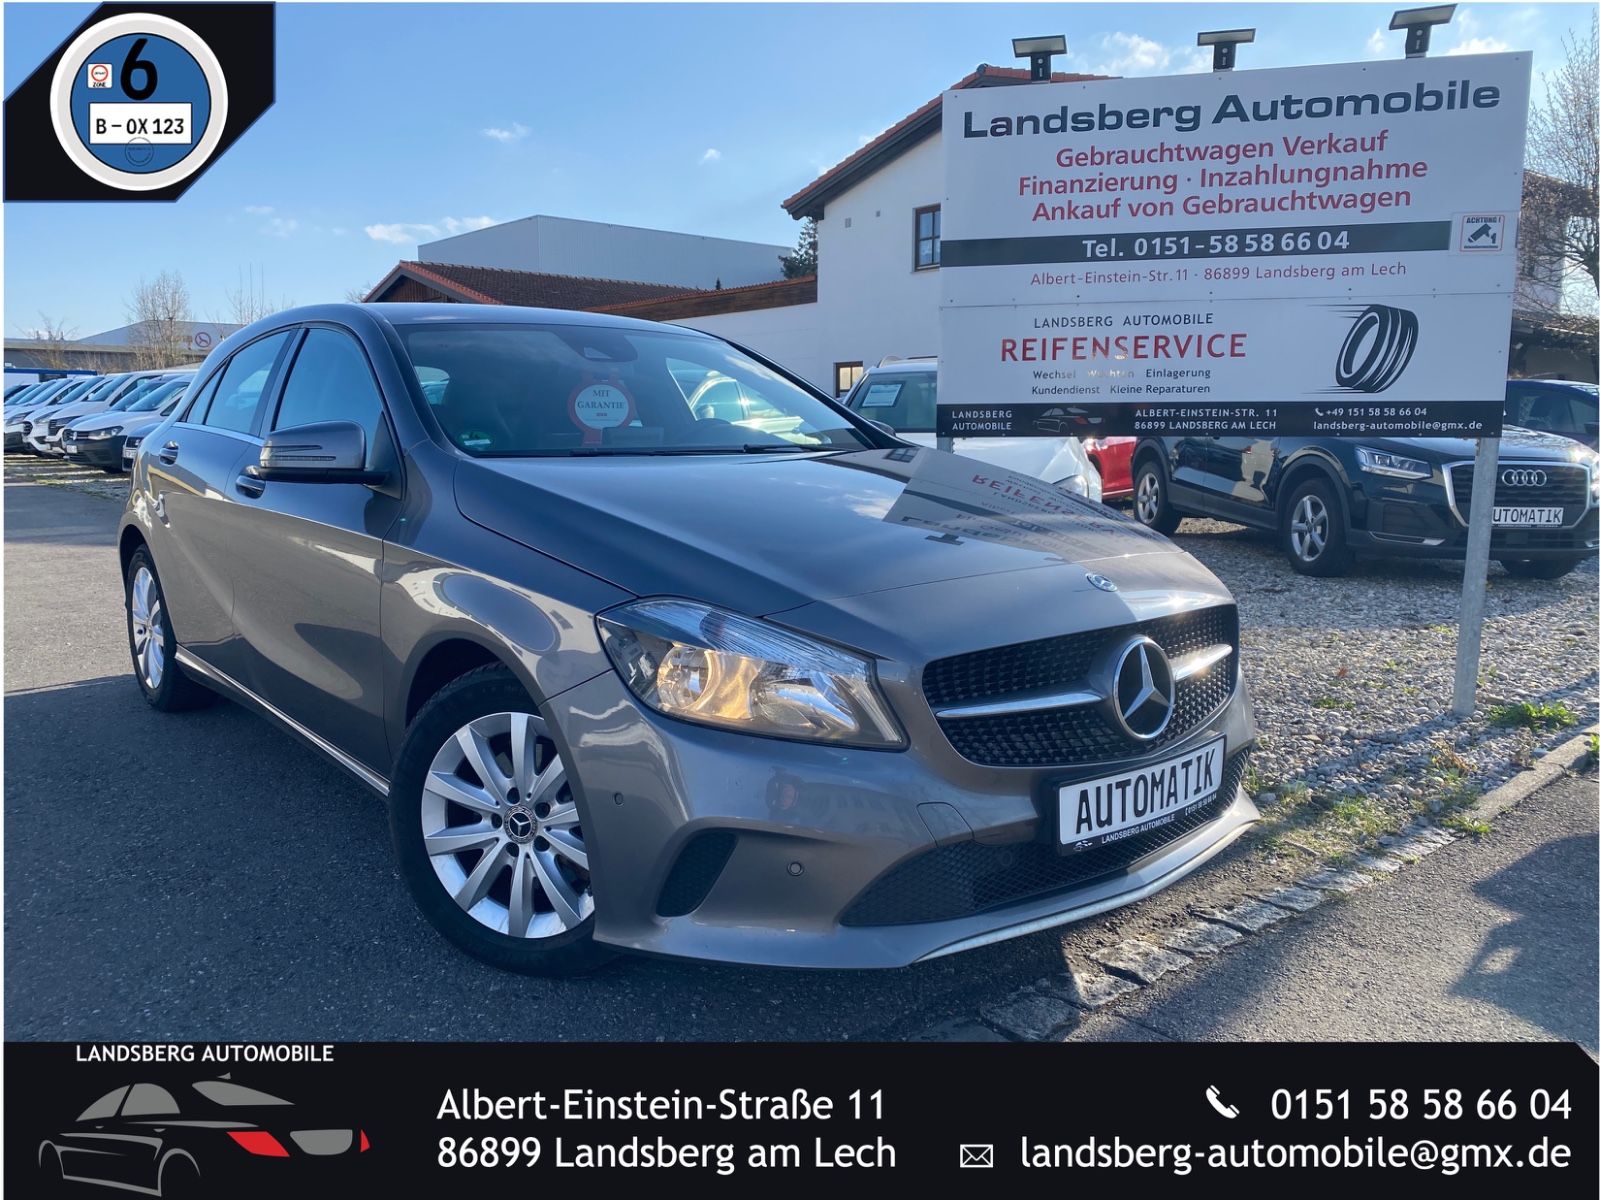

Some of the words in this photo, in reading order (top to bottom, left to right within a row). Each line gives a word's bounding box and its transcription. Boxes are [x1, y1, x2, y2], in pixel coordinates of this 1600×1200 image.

[964, 103, 1201, 139] Landsberg
[1212, 80, 1500, 124] Automobile
[1056, 142, 1274, 168] Gebrauchtwagen
[1282, 129, 1389, 157] Verkauf
[1019, 173, 1178, 196] Finanzierung
[1200, 159, 1428, 188] Inzahlungnahme
[1032, 198, 1121, 221] Ankauf
[1128, 201, 1174, 217] von
[1182, 190, 1411, 215] Gebrauchtwagen
[1082, 238, 1124, 258] Tel.
[1245, 233, 1274, 252] 58
[1281, 232, 1311, 251] 66
[1317, 231, 1350, 250] 04
[1203, 266, 1250, 280] 86899
[1256, 265, 1335, 280] Landsberg
[1341, 267, 1365, 277] am
[1371, 262, 1407, 276] Lech
[1034, 316, 1113, 329] LANDSBERG
[1123, 313, 1214, 327] AUTOMOBILE
[1001, 333, 1247, 362] REIFENSERVICE
[1033, 369, 1076, 379] Wechsel
[1145, 368, 1211, 379] Einlagerung
[592, 389, 610, 397] MIT
[1032, 385, 1100, 395] Kundendienst
[1110, 384, 1142, 394] Kleine
[1145, 385, 1211, 395] Reparaturen
[577, 401, 625, 409] GARANTIE
[1135, 408, 1260, 417] ALBERT-EINSTEIN-STR.
[1266, 409, 1278, 417] 11
[1326, 408, 1344, 416] +49
[1348, 408, 1364, 416] 151
[1369, 408, 1381, 416] 58
[1384, 408, 1396, 416] 58
[1399, 408, 1412, 416] 66
[1414, 408, 1427, 416] 04
[952, 410, 1013, 418] LANDSBERG
[952, 421, 1012, 430] AUTOMOBILE
[1134, 421, 1166, 430] 86899
[1169, 421, 1229, 430] LANDSBERG
[1231, 420, 1247, 430] AM
[1250, 420, 1277, 430] LECH
[1313, 421, 1483, 431] landsberg-automobile@gmx.de
[1492, 508, 1562, 523] UTOMATIK
[1075, 748, 1215, 834] AUTOMATIK
[1101, 826, 1140, 844] LANDSBERG
[1140, 813, 1175, 832] AUTOMOBILE
